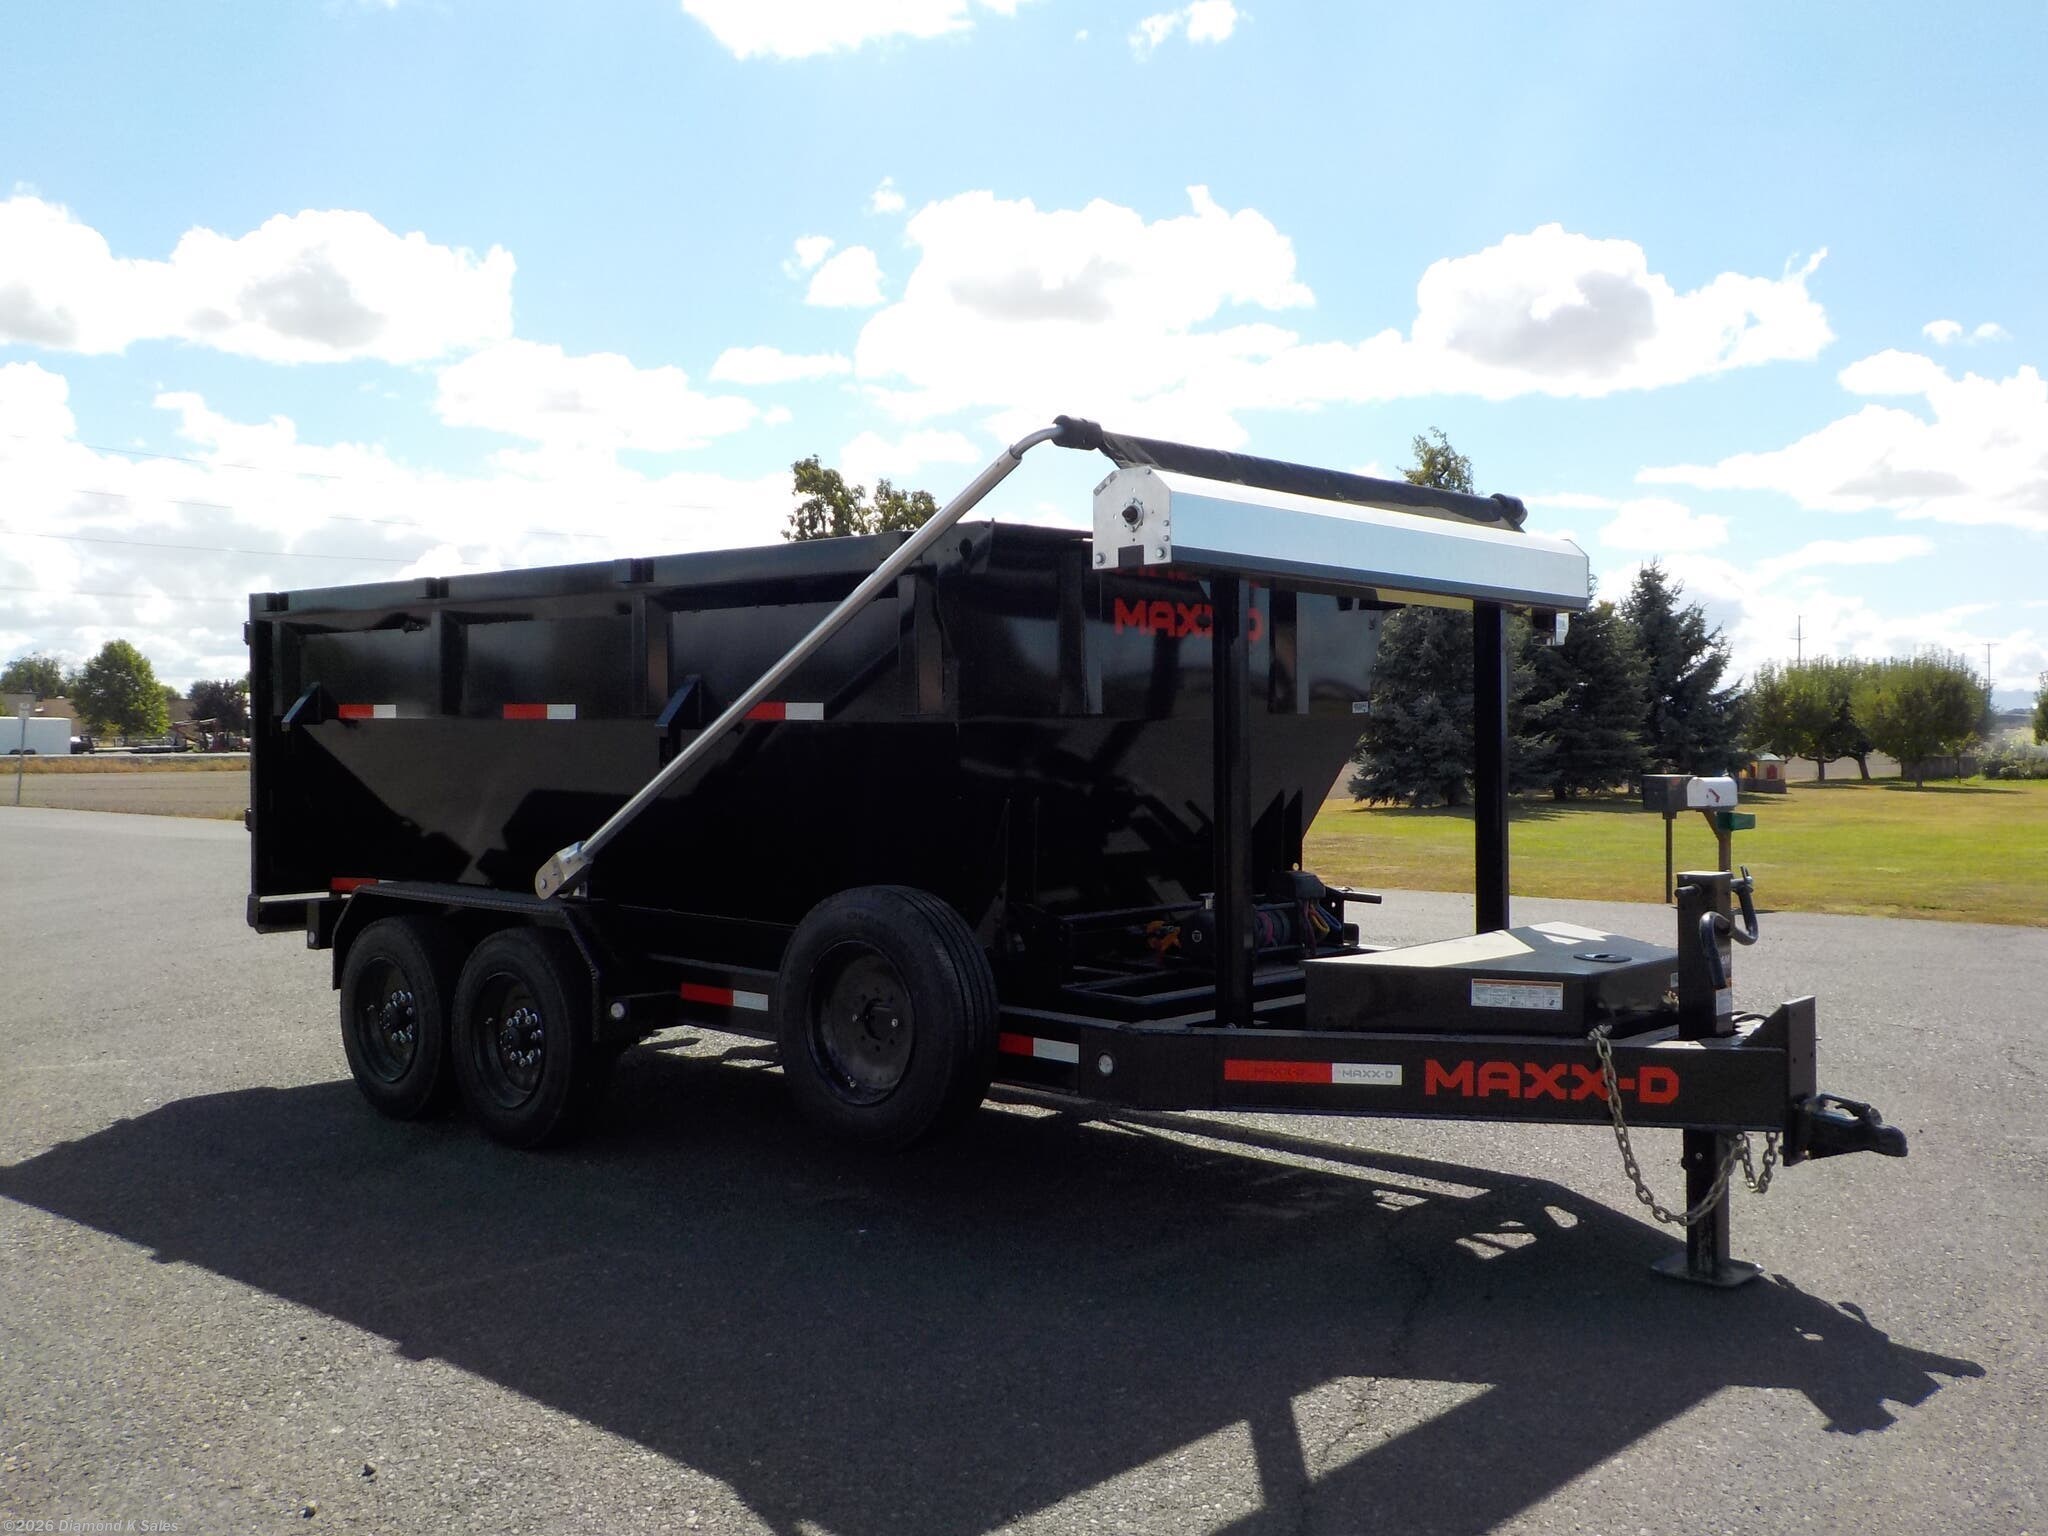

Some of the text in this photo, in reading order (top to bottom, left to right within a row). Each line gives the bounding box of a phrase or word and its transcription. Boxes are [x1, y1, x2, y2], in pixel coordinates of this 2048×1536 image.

[1114, 597, 1264, 641] MAXD
[1342, 1069, 1394, 1079] MAXX-D
[1424, 1059, 1680, 1105] MAXX-D
